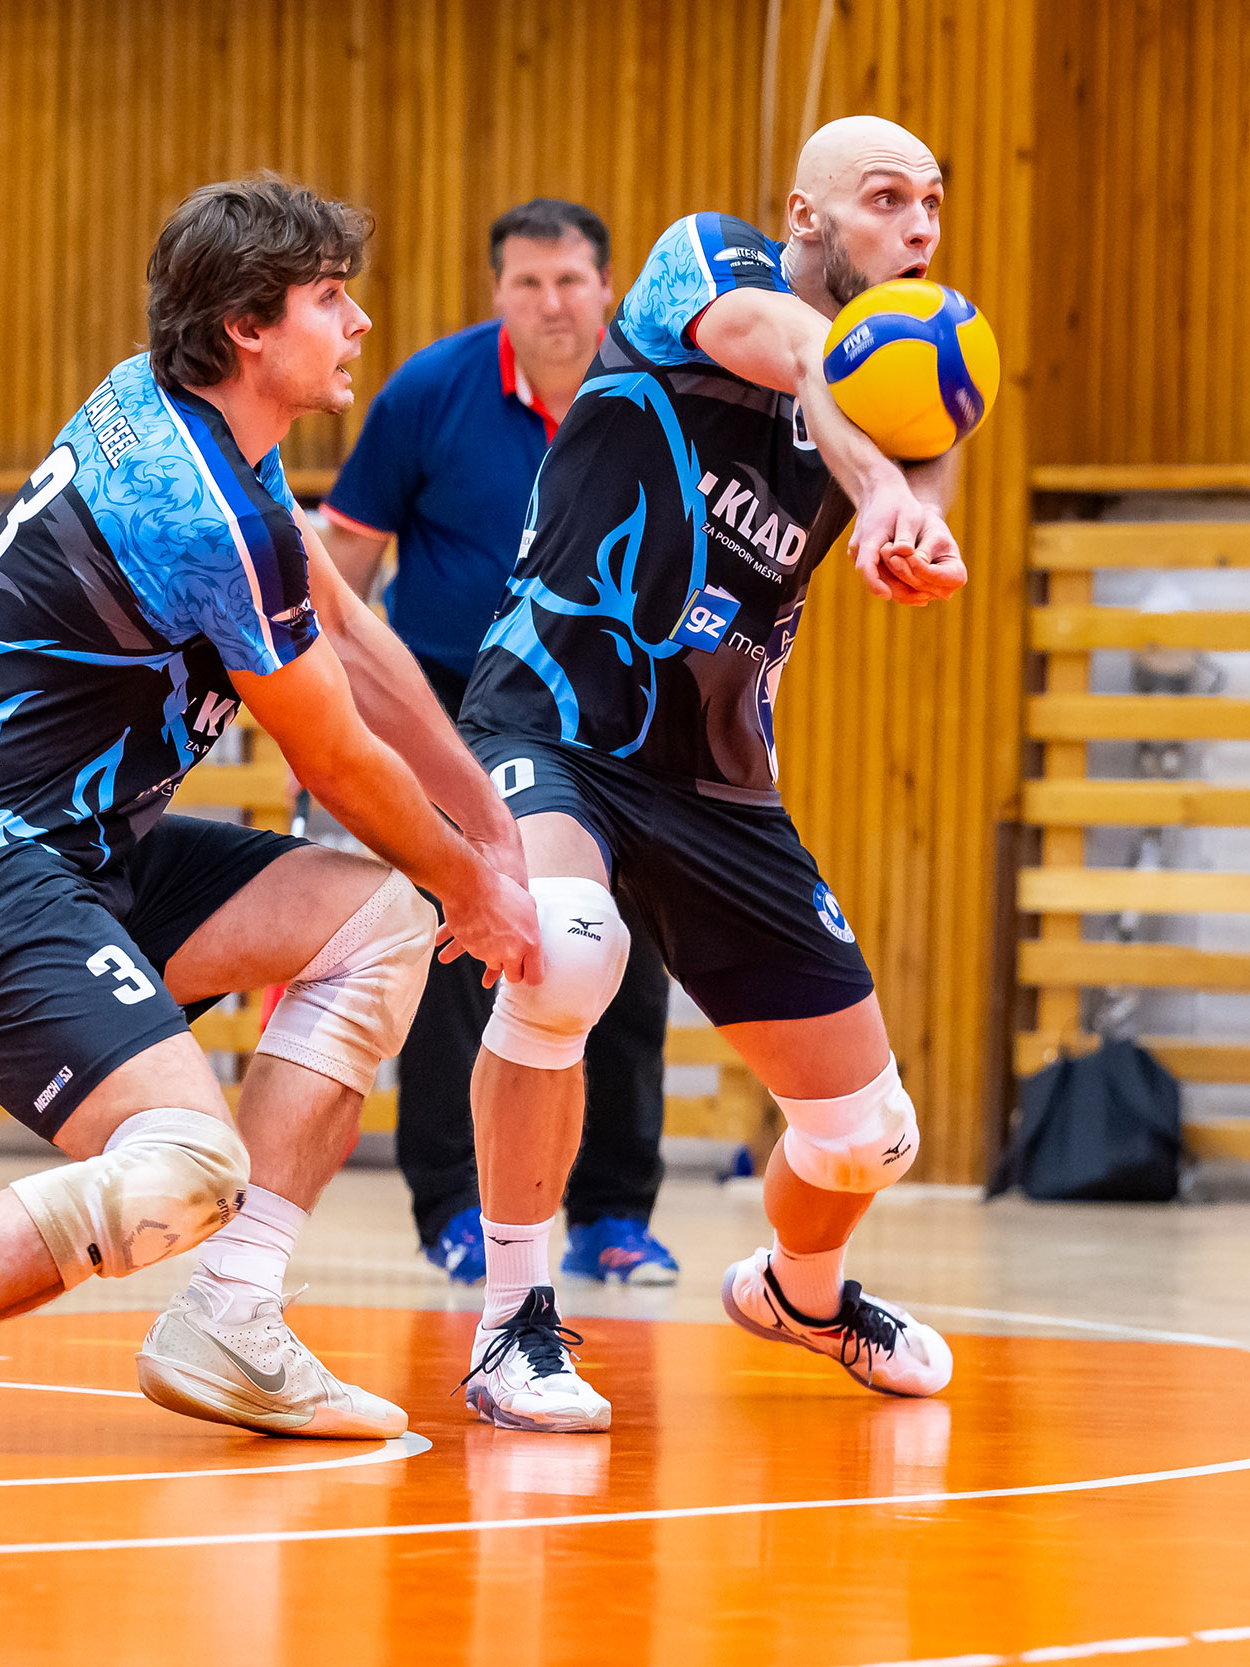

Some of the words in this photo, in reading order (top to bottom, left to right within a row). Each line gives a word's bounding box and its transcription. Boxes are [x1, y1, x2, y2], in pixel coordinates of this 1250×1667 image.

[96, 415, 140, 471] GEEL
[701, 521, 716, 537] ZA
[715, 531, 755, 565] PODPORY
[712, 478, 807, 566] KLAD
[685, 606, 727, 639] gz
[728, 631, 766, 662] me
[86, 944, 157, 1005] 3
